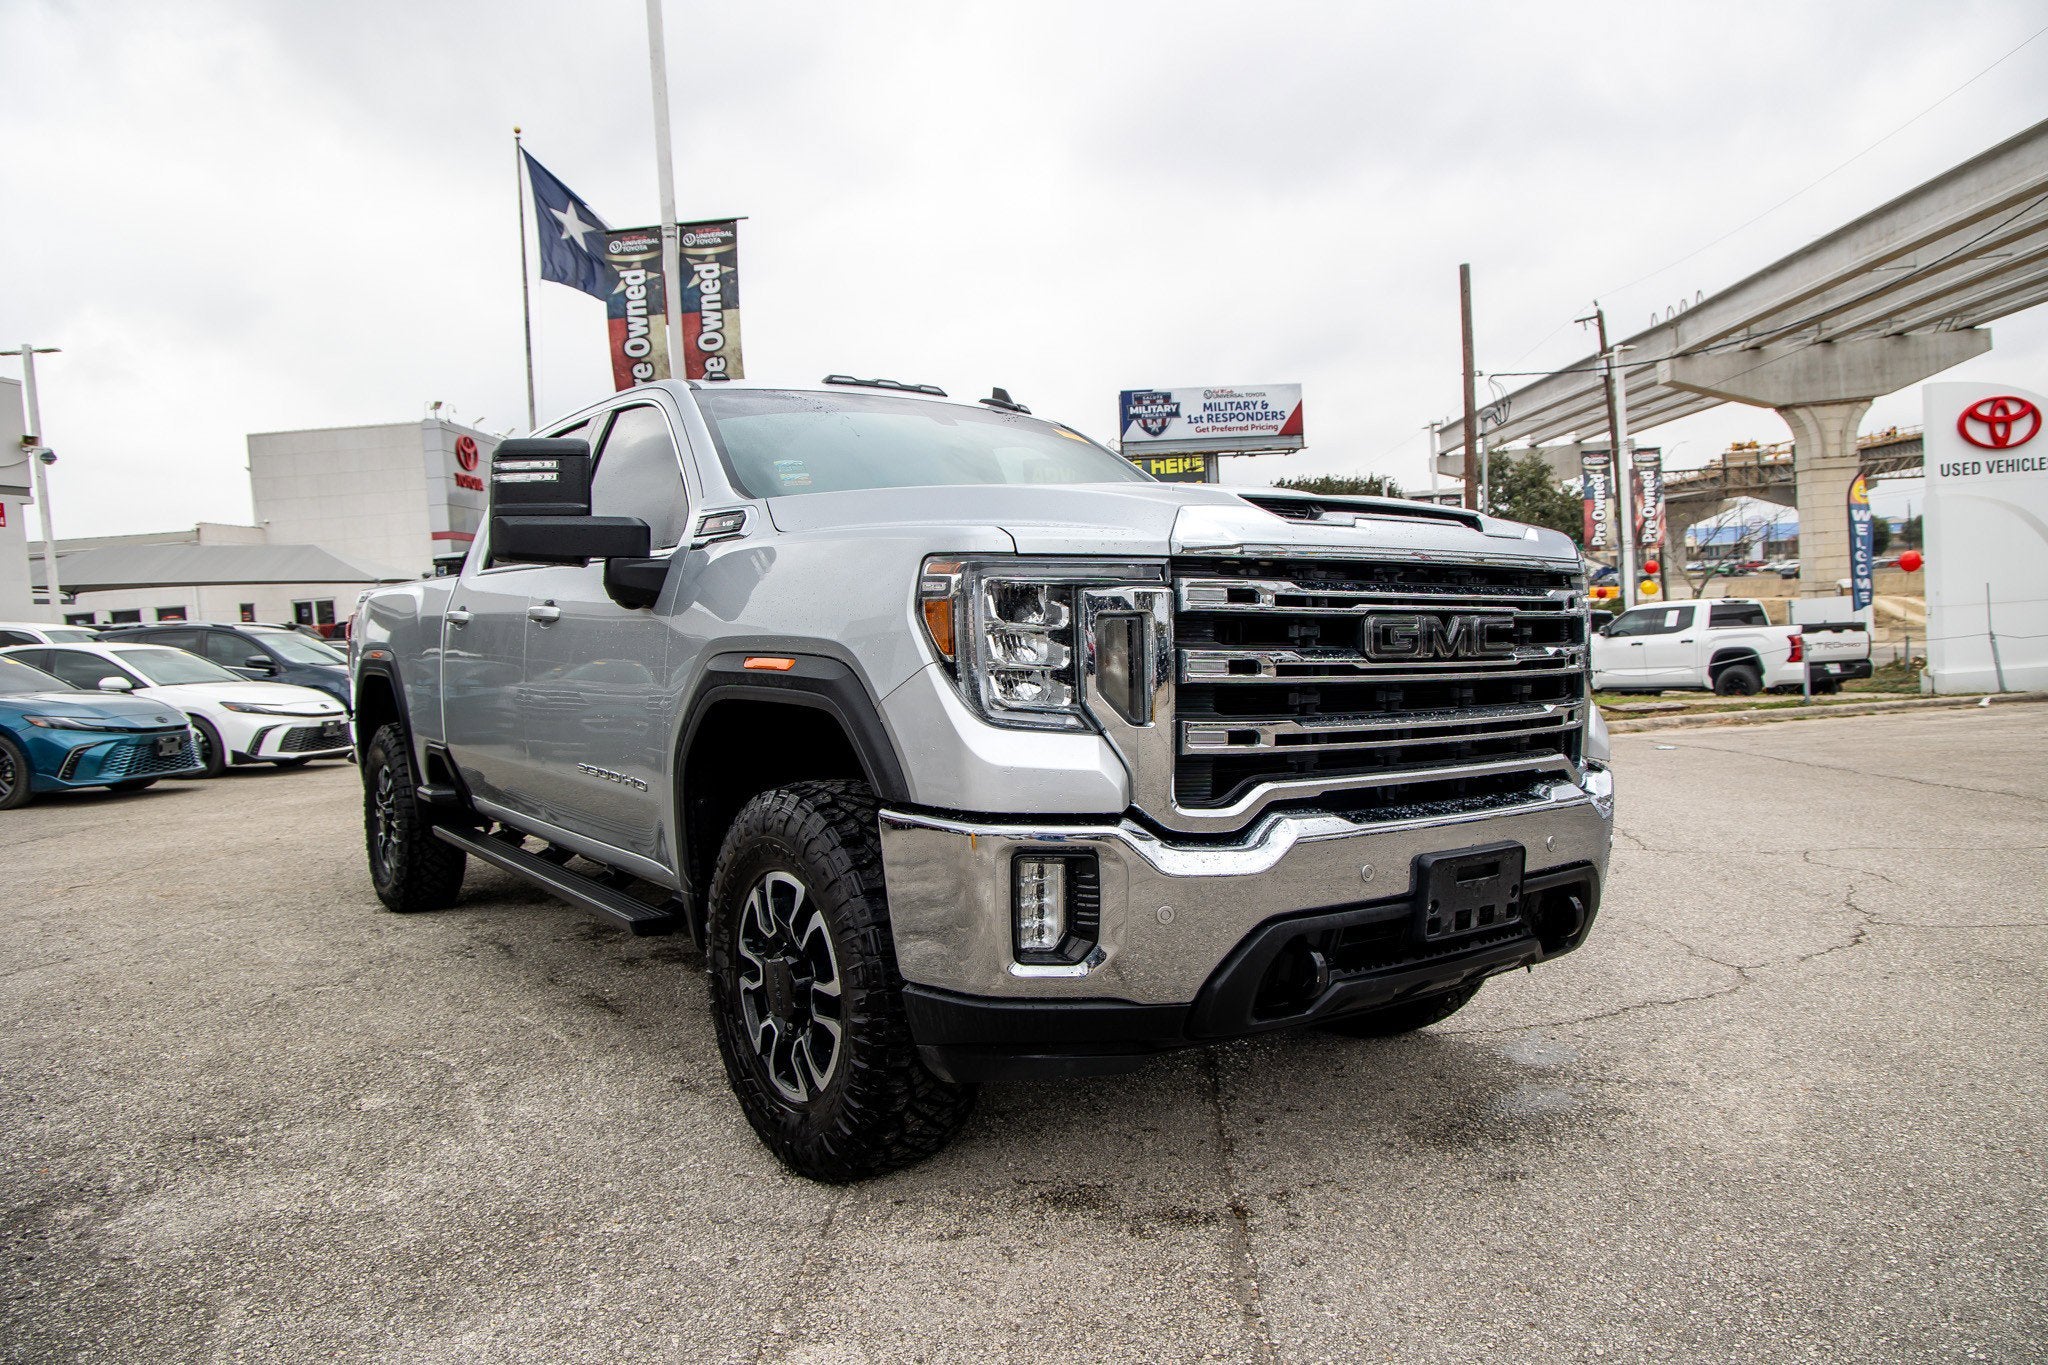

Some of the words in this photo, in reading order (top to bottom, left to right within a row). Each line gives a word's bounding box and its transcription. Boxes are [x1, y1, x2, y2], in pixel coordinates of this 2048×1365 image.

[696, 230, 733, 239] UNIVERSAL
[622, 237, 659, 246] UNIVERSAL
[696, 238, 721, 246] TOYOTA
[622, 244, 648, 253] TOYOTA
[619, 268, 651, 358] Owned
[693, 262, 725, 352] Owned
[1129, 404, 1178, 415] MILITARY
[1203, 400, 1258, 412] MILITARY
[1260, 400, 1269, 410] &
[1187, 414, 1204, 424] 1st
[1207, 410, 1286, 424] RESPONDERS
[1195, 425, 1209, 433] Get
[1211, 424, 1249, 432] Preferred
[1250, 423, 1279, 432] Pricing
[1150, 457, 1205, 475] HERE
[1940, 461, 1981, 477] USED
[1986, 456, 2048, 474] VEHICLE
[1851, 509, 1872, 603] WELCOME
[1363, 614, 1515, 659] GMC
